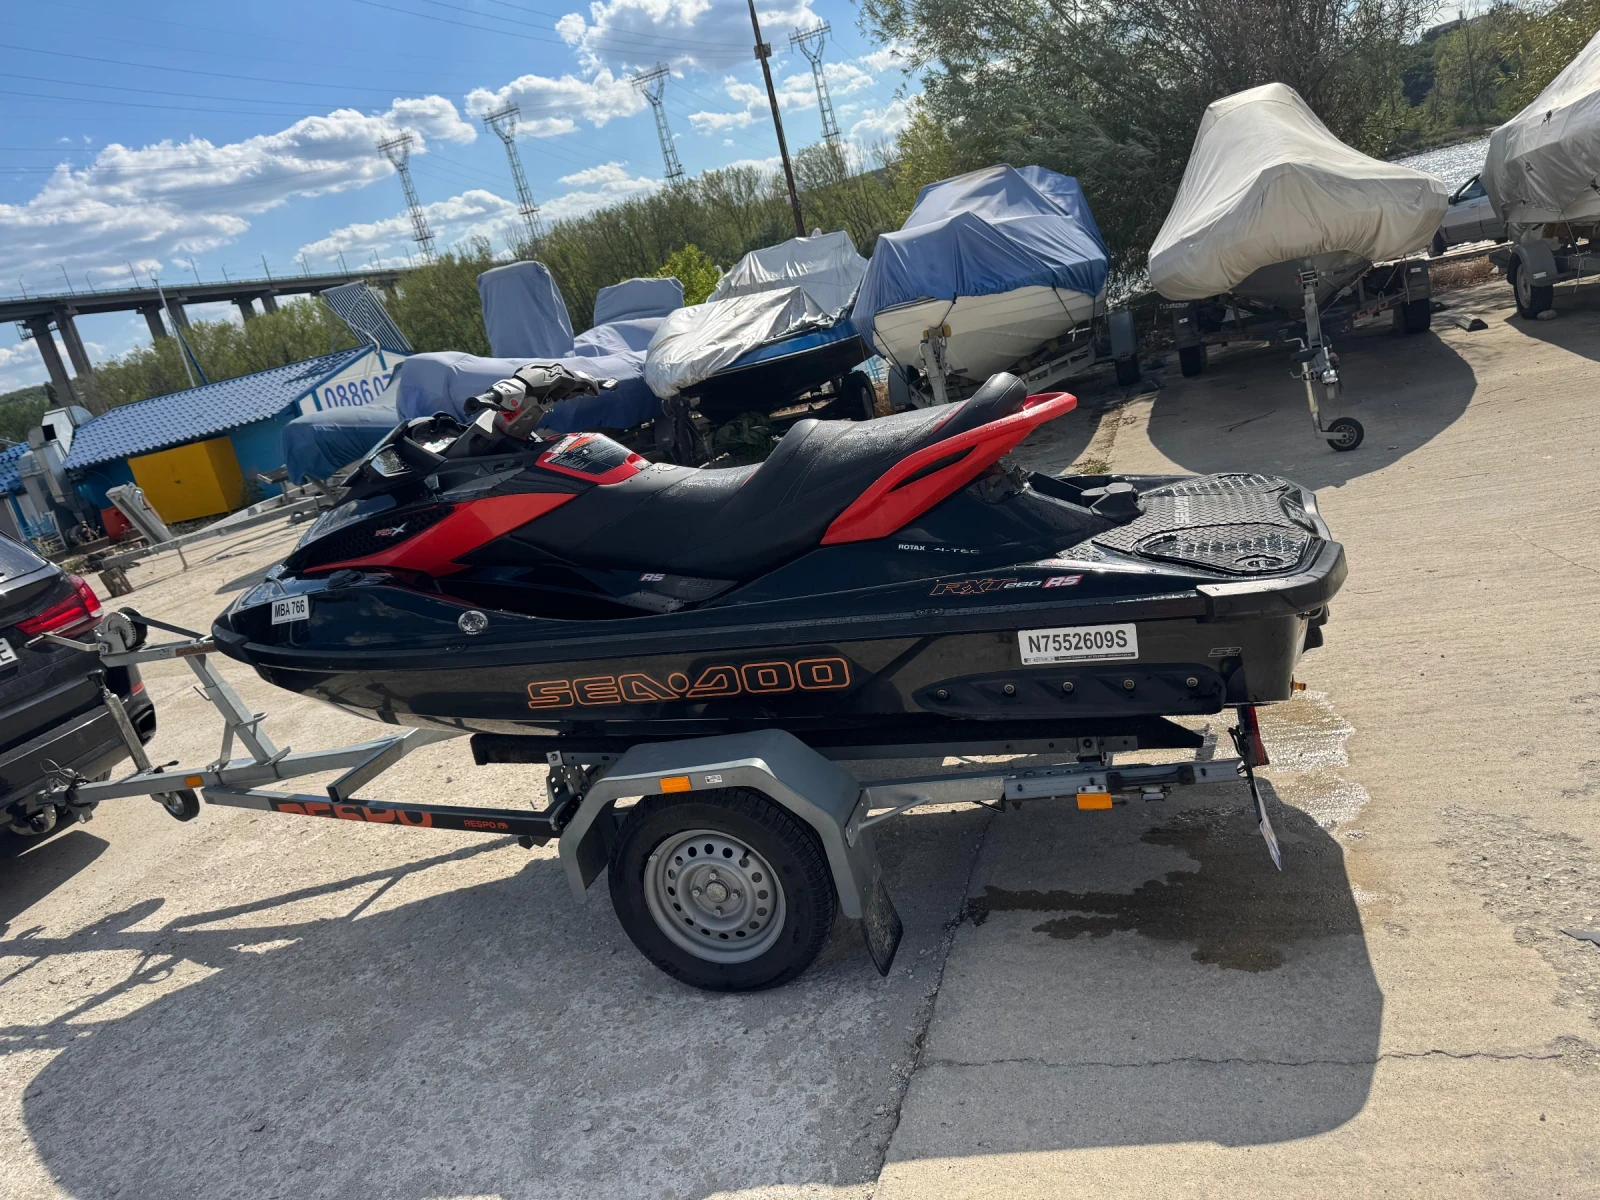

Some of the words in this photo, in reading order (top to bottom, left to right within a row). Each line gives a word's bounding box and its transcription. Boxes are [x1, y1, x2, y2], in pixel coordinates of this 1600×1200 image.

[324, 374, 392, 408] 08860
[930, 578, 1018, 595] RXT
[1004, 580, 1042, 588] 260
[274, 603, 290, 618] MBA
[291, 600, 305, 614] 766
[1028, 629, 1128, 653] N7552609S
[463, 819, 496, 829] RESPO
